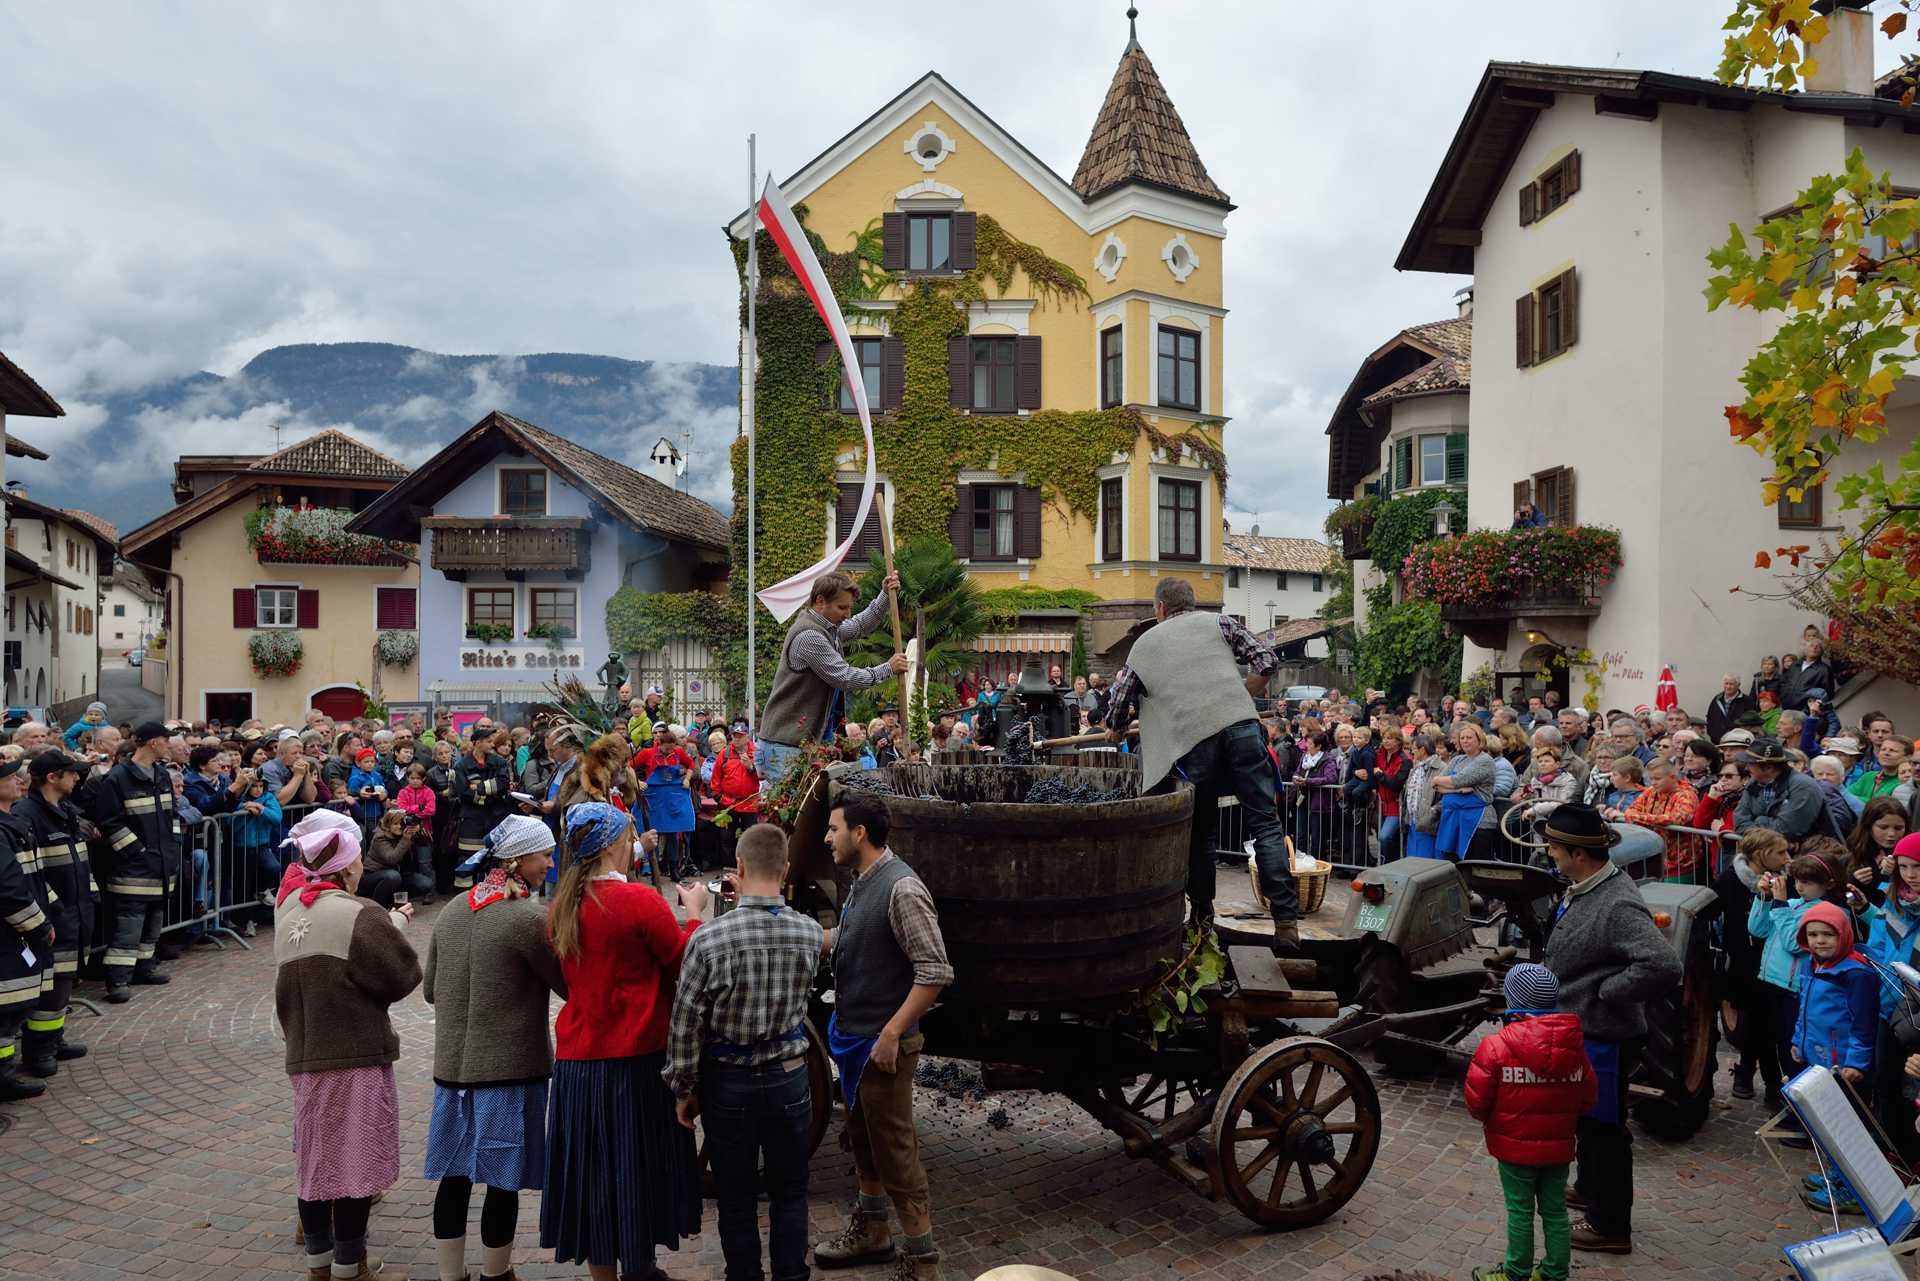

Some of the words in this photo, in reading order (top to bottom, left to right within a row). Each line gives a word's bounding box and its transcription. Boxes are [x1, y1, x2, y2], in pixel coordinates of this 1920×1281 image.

[1622, 668, 1643, 679] Platz
[1360, 905, 1375, 916] BZ
[1359, 916, 1384, 929] 1307
[1502, 1065, 1583, 1083] BENON
